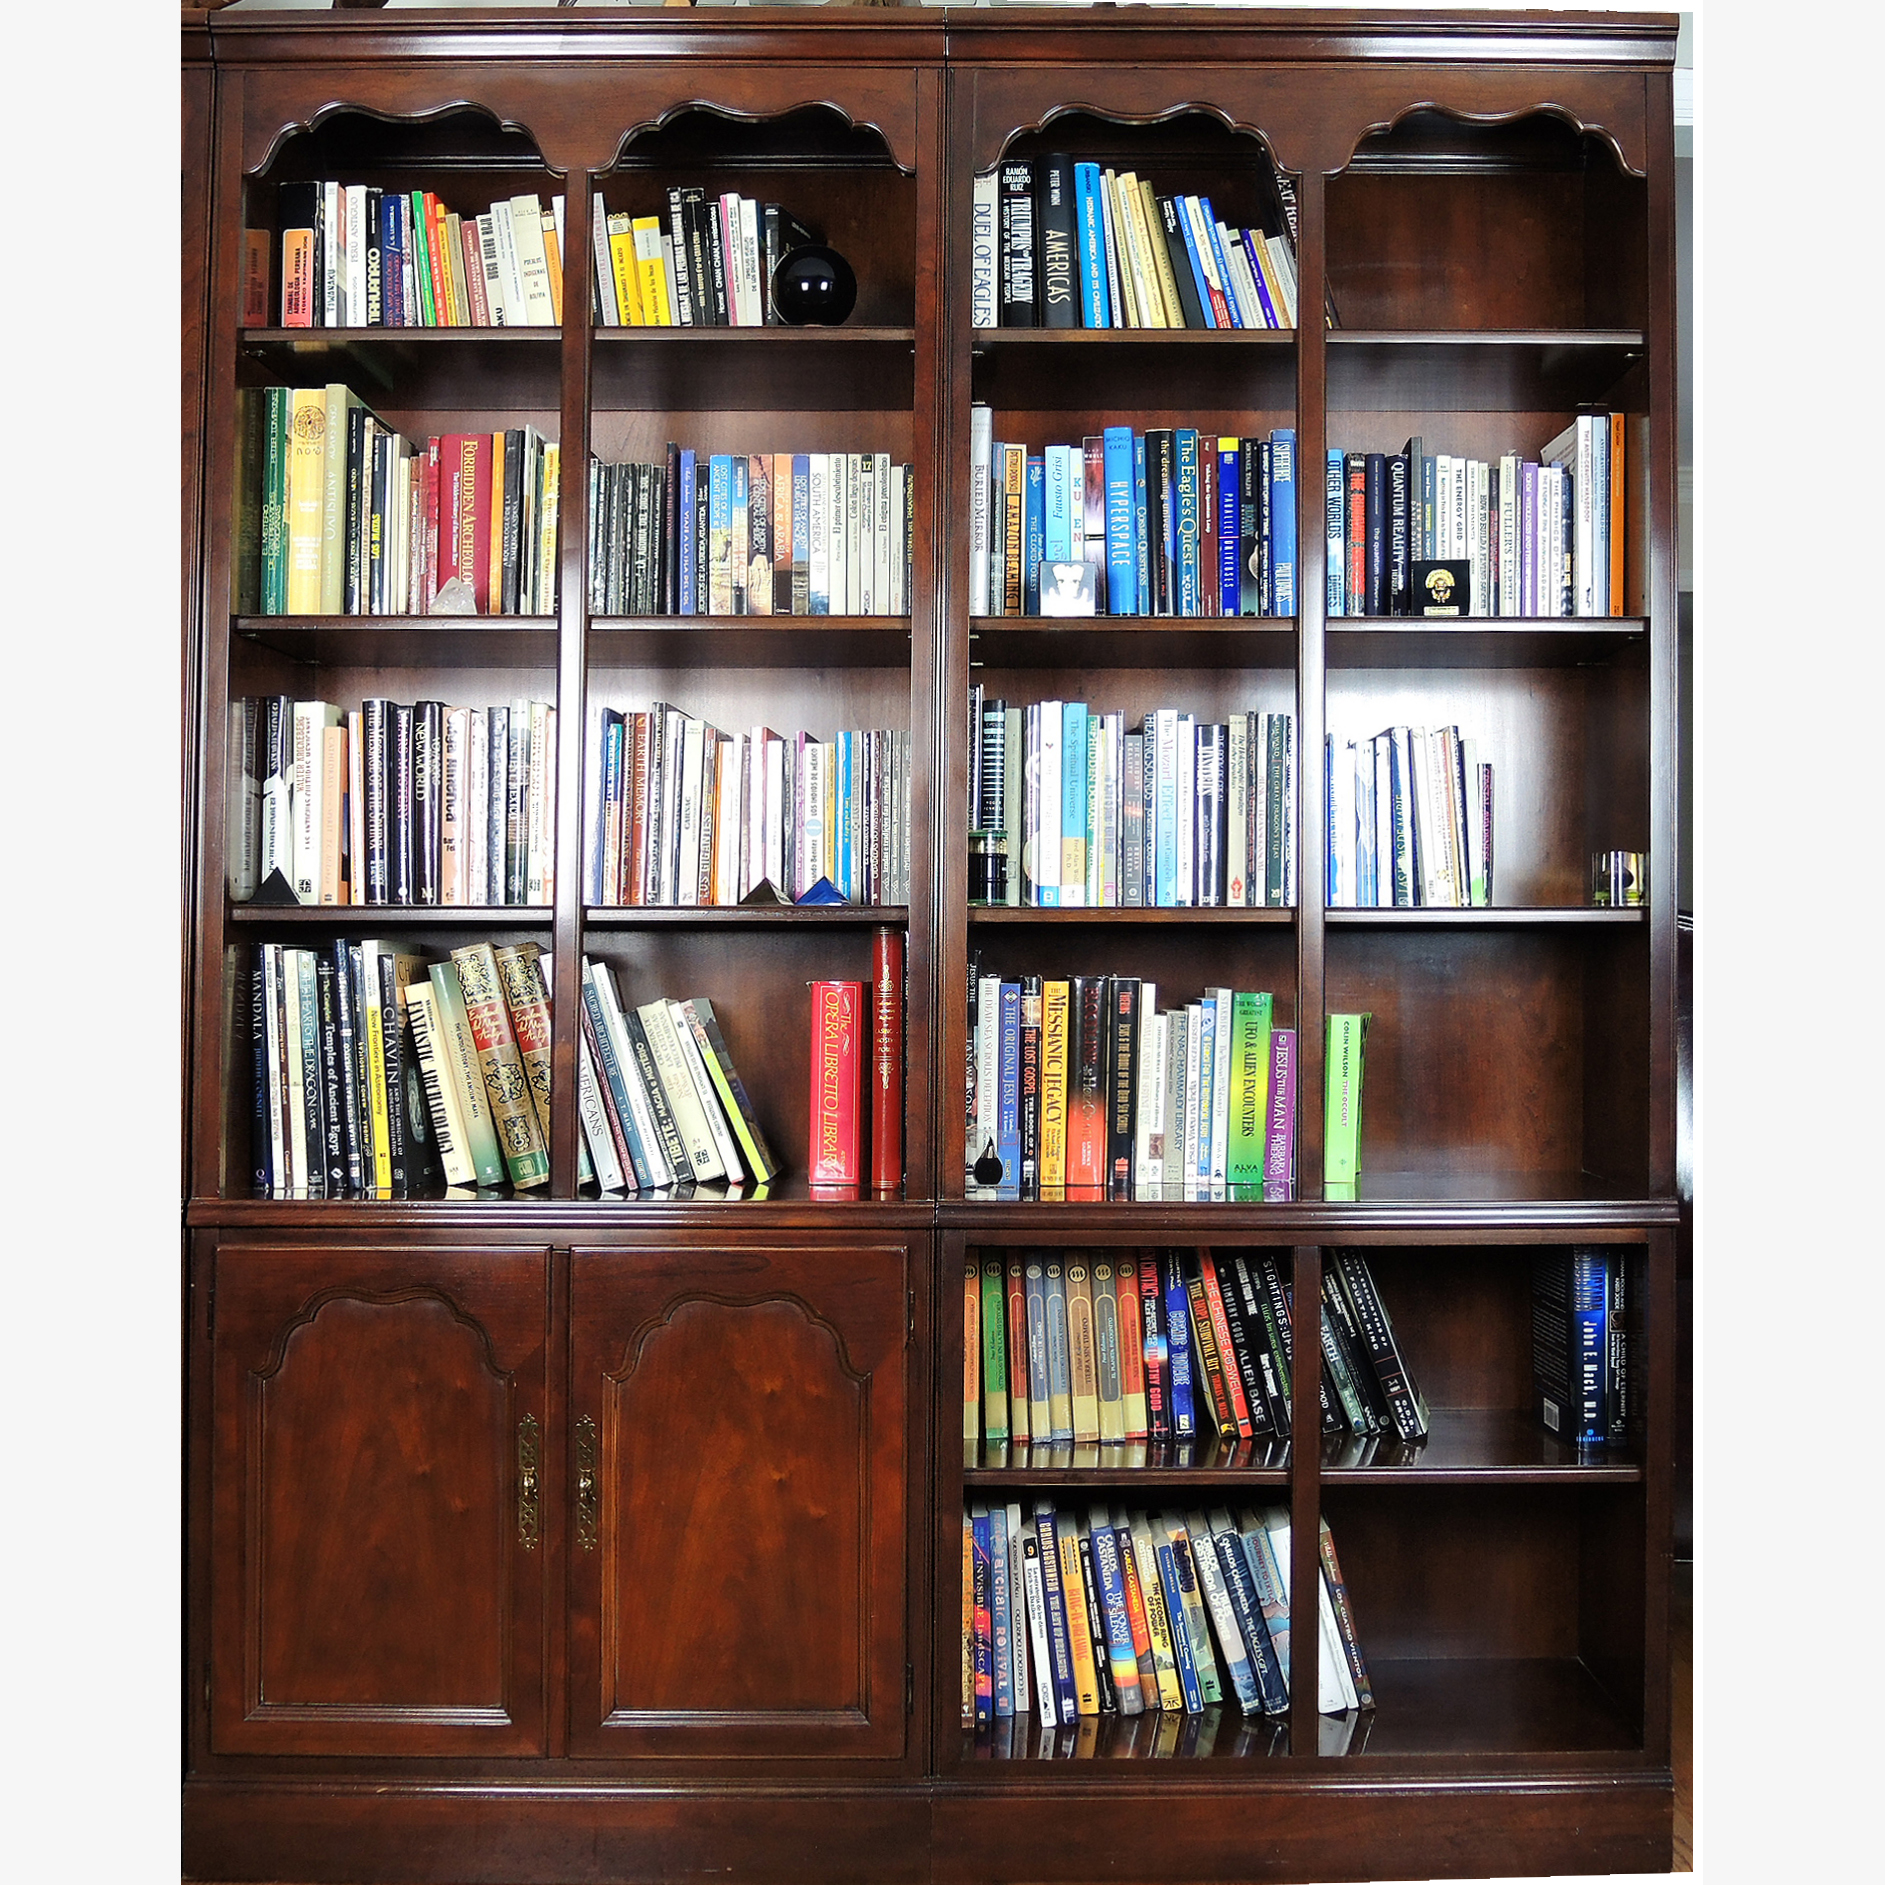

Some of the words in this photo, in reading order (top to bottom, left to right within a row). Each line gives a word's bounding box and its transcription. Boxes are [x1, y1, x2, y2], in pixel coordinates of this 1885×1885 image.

[350, 197, 359, 238] ANTIGUO
[973, 203, 992, 243] DUEL
[1010, 197, 1033, 251] TRIUMPHS
[349, 242, 359, 262] PERÚ
[973, 244, 992, 265] OF
[1045, 230, 1071, 304] AMERICAS
[325, 269, 336, 313] TIWANAKU
[973, 268, 992, 327] EAGLES
[1010, 256, 1033, 304] TRAGEDY
[1160, 439, 1169, 454] the
[1181, 436, 1195, 463] The
[462, 440, 479, 512] FORBIDDEN
[832, 457, 842, 504] descubrimiento
[879, 456, 888, 500] precolombino
[974, 464, 985, 506] BURIED
[1051, 455, 1063, 482] Grisi
[1160, 457, 1171, 501] dreaming
[1327, 459, 1341, 494] OTHER
[775, 474, 785, 510] AFRICA
[811, 472, 821, 506] SOUTH
[1051, 484, 1063, 519] Fausto
[1178, 465, 1196, 516] Eagle's
[1390, 461, 1405, 516] QUANTUM
[811, 509, 821, 554] AMERICA
[974, 507, 985, 552] MIRROR
[1007, 504, 1019, 550] AMAZON
[1110, 480, 1131, 566] HYPERSPACE
[1136, 507, 1146, 540] COSMIC
[1162, 503, 1170, 542] universe
[1223, 493, 1234, 535] PARALLEL
[1327, 497, 1341, 540] WORLDS
[1503, 501, 1513, 555] FULLER'S
[775, 525, 785, 562] ARABIA
[1177, 518, 1197, 566] Quest
[1372, 541, 1381, 575] quantum
[1392, 518, 1405, 564] REALITY
[1007, 553, 1019, 599] BEAMING
[1137, 541, 1148, 586] QUESTIONS
[296, 716, 305, 761] KRICKEBERG
[1070, 719, 1079, 734] The
[1143, 717, 1156, 760] HEALING
[1163, 717, 1173, 736] The
[636, 734, 646, 772] EARTH
[1067, 739, 1079, 777] Spiritual
[1161, 739, 1174, 780] Mozart
[1143, 760, 1156, 801] SOUNDS
[635, 776, 645, 826] MEMORY
[1069, 779, 1079, 819] Universe
[1161, 847, 1174, 883] Campbell
[252, 970, 264, 1040] MANDALA
[585, 989, 605, 1020] SACRED
[984, 982, 994, 997] THE
[370, 1010, 379, 1029] New
[824, 991, 841, 1041] OPERA
[839, 1012, 852, 1032] The
[984, 998, 994, 1023] DEAD
[1004, 1005, 1016, 1026] THE
[1178, 1014, 1187, 1032] THE
[323, 1023, 337, 1067] Temples
[371, 1029, 381, 1063] Frontiers
[383, 1006, 399, 1084] CHAVIN
[984, 1023, 994, 1040] SEA
[1023, 1029, 1036, 1044] THE
[1047, 994, 1066, 1069] MESSIANIC
[1177, 1034, 1186, 1057] NAG
[1244, 1021, 1258, 1040] UFO
[1342, 1020, 1350, 1045] COLIN
[594, 1021, 618, 1079] ARCHITECTURE
[635, 1042, 655, 1081] MISTÉRIO
[984, 1041, 993, 1077] SCROLLS
[1003, 1028, 1015, 1076] ORIGINAL
[1023, 1046, 1036, 1064] LOST
[1243, 1050, 1257, 1077] ALIEN
[1275, 1045, 1289, 1080] JESUS
[1341, 1046, 1349, 1078] WILSON
[407, 999, 435, 1064] FANTASTIC
[421, 1068, 455, 1156] ARCHAEOLOGY
[824, 1042, 840, 1110] LIBRETTO
[1003, 1079, 1015, 1105] JESUS
[1023, 1066, 1036, 1095] GOSPEL
[1175, 1058, 1185, 1110] HAMMADI
[1341, 1080, 1349, 1096] THE
[328, 1083, 338, 1122] Ancient
[374, 1073, 384, 1116] Astronomy
[651, 1087, 668, 1118] MAGIA
[1043, 1072, 1062, 1126] LEGACY
[1240, 1078, 1256, 1137] ENCOUNTERS
[1273, 1095, 1287, 1130] MAN
[1341, 1096, 1349, 1127] OCCULT
[328, 1124, 341, 1156] Egypt
[659, 1118, 686, 1167] TIBETE:
[823, 1112, 840, 1172] LIBRARY
[1173, 1112, 1184, 1151] LIBRARY
[1234, 1163, 1258, 1172] ALVA
[1189, 1282, 1204, 1300] THE
[1221, 1282, 1239, 1318] TIMOTHY
[1168, 1309, 1187, 1346] COSMIC
[1193, 1300, 1207, 1320] HOPI
[1349, 1276, 1369, 1319] FOURTH
[1366, 1322, 1380, 1350] KIND
[1197, 1321, 1216, 1358] SURVIVAL
[1205, 1275, 1217, 1298] THE
[1211, 1301, 1230, 1347] CHINESE
[1223, 1348, 1242, 1401] ROSWELL
[1231, 1321, 1246, 1344] GOOD
[1582, 1320, 1598, 1346] John
[1144, 1347, 1161, 1385] TIMOTHY
[1171, 1351, 1191, 1386] VOYAGE
[1205, 1358, 1220, 1372] KIT
[1237, 1348, 1256, 1386] ALIEN
[1582, 1364, 1598, 1396] Mack,
[1149, 1387, 1162, 1411] GOOD
[1248, 1388, 1266, 1424] BASE
[1394, 1399, 1410, 1433] BRYAN
[1039, 1522, 1056, 1551] CARLOS
[1105, 1533, 1117, 1572] CARLOS
[1202, 1536, 1219, 1571] CARLOS
[1042, 1550, 1059, 1592] CASTANEDA
[1096, 1535, 1112, 1591] CASTANEDA
[1123, 1548, 1135, 1575] CARLOS
[1193, 1538, 1214, 1591] CASTANEDA
[1049, 1595, 1061, 1611] THE
[1106, 1592, 1116, 1606] OF
[1114, 1590, 1124, 1606] THE
[1127, 1575, 1141, 1614] CASTANEDA
[1152, 1581, 1160, 1596] THE
[1219, 1589, 1232, 1616] TALES
[1221, 1537, 1237, 1569] CARLOS
[1230, 1569, 1250, 1614] CASTANEDA
[1256, 1656, 1269, 1674] GIFT
[1335, 1588, 1346, 1604] LOS
[1052, 1611, 1063, 1626] ART
[1067, 1587, 1089, 1661] BEING-IN-DREAMING
[1109, 1608, 1122, 1644] SILENCE
[1117, 1607, 1130, 1644] POWER
[1148, 1609, 1160, 1638] POWER
[1154, 1596, 1166, 1627] SECOND
[1214, 1607, 1231, 1640] POWER
[1339, 1606, 1354, 1641] CUATRO
[1159, 1627, 1170, 1648] RING
[1054, 1638, 1068, 1680] DREAMING
[1349, 1642, 1363, 1678] VIENTOS
